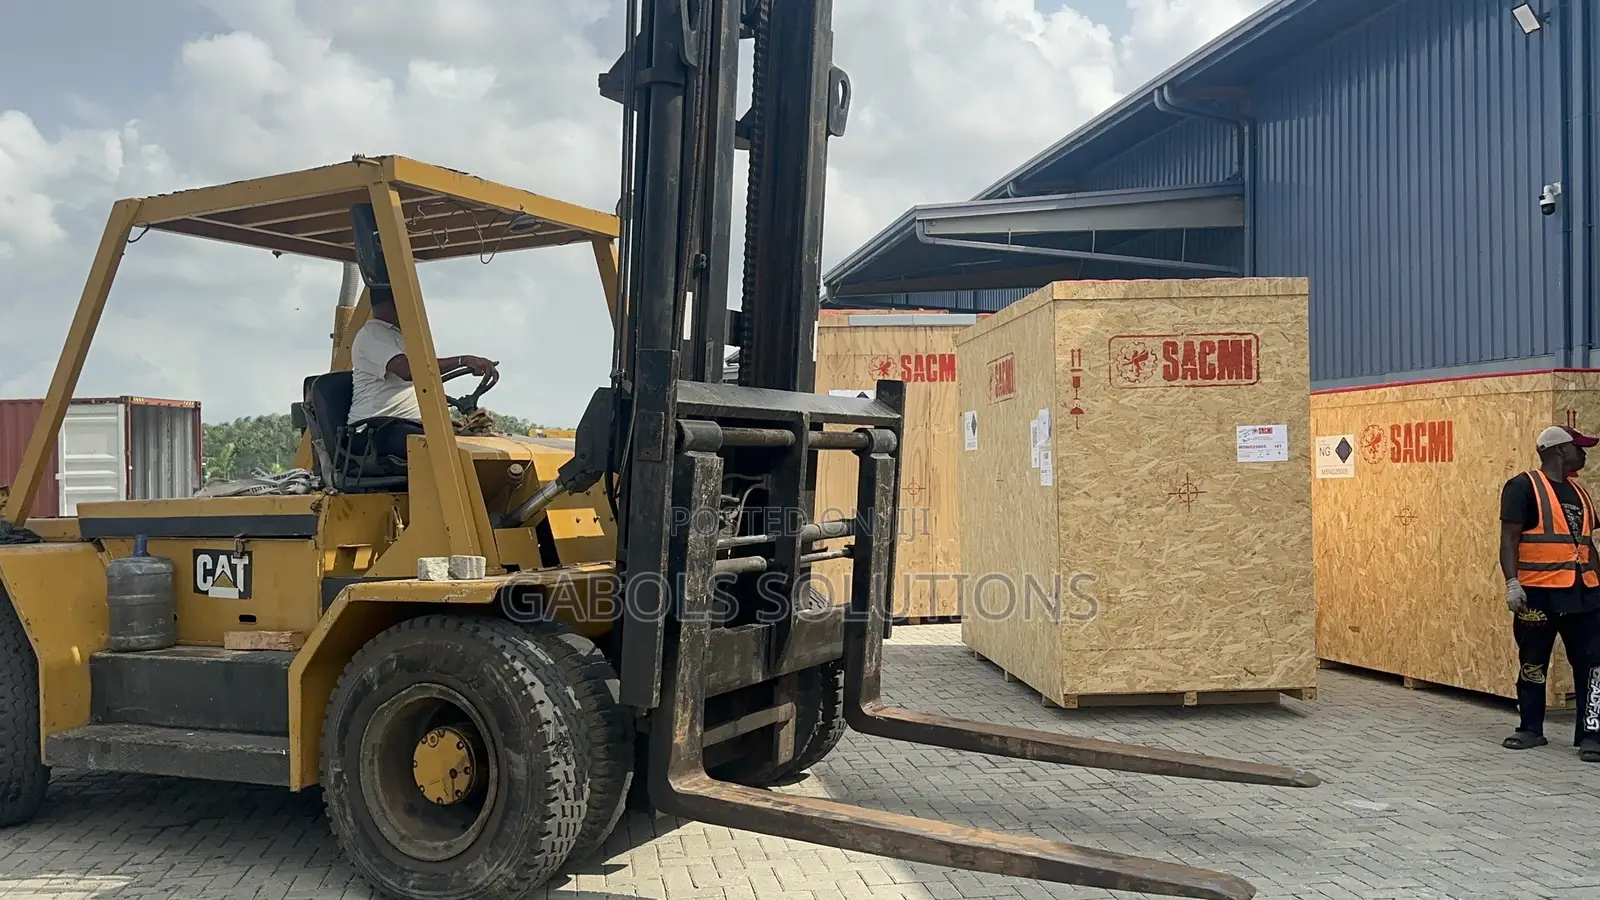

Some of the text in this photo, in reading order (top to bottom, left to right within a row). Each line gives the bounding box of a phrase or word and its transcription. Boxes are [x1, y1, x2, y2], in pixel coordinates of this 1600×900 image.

[900, 353, 957, 383] SACM
[1162, 339, 1253, 382] SACMI
[1319, 446, 1331, 457] NG
[1389, 420, 1454, 464] SACMI
[196, 553, 249, 593] CAT
